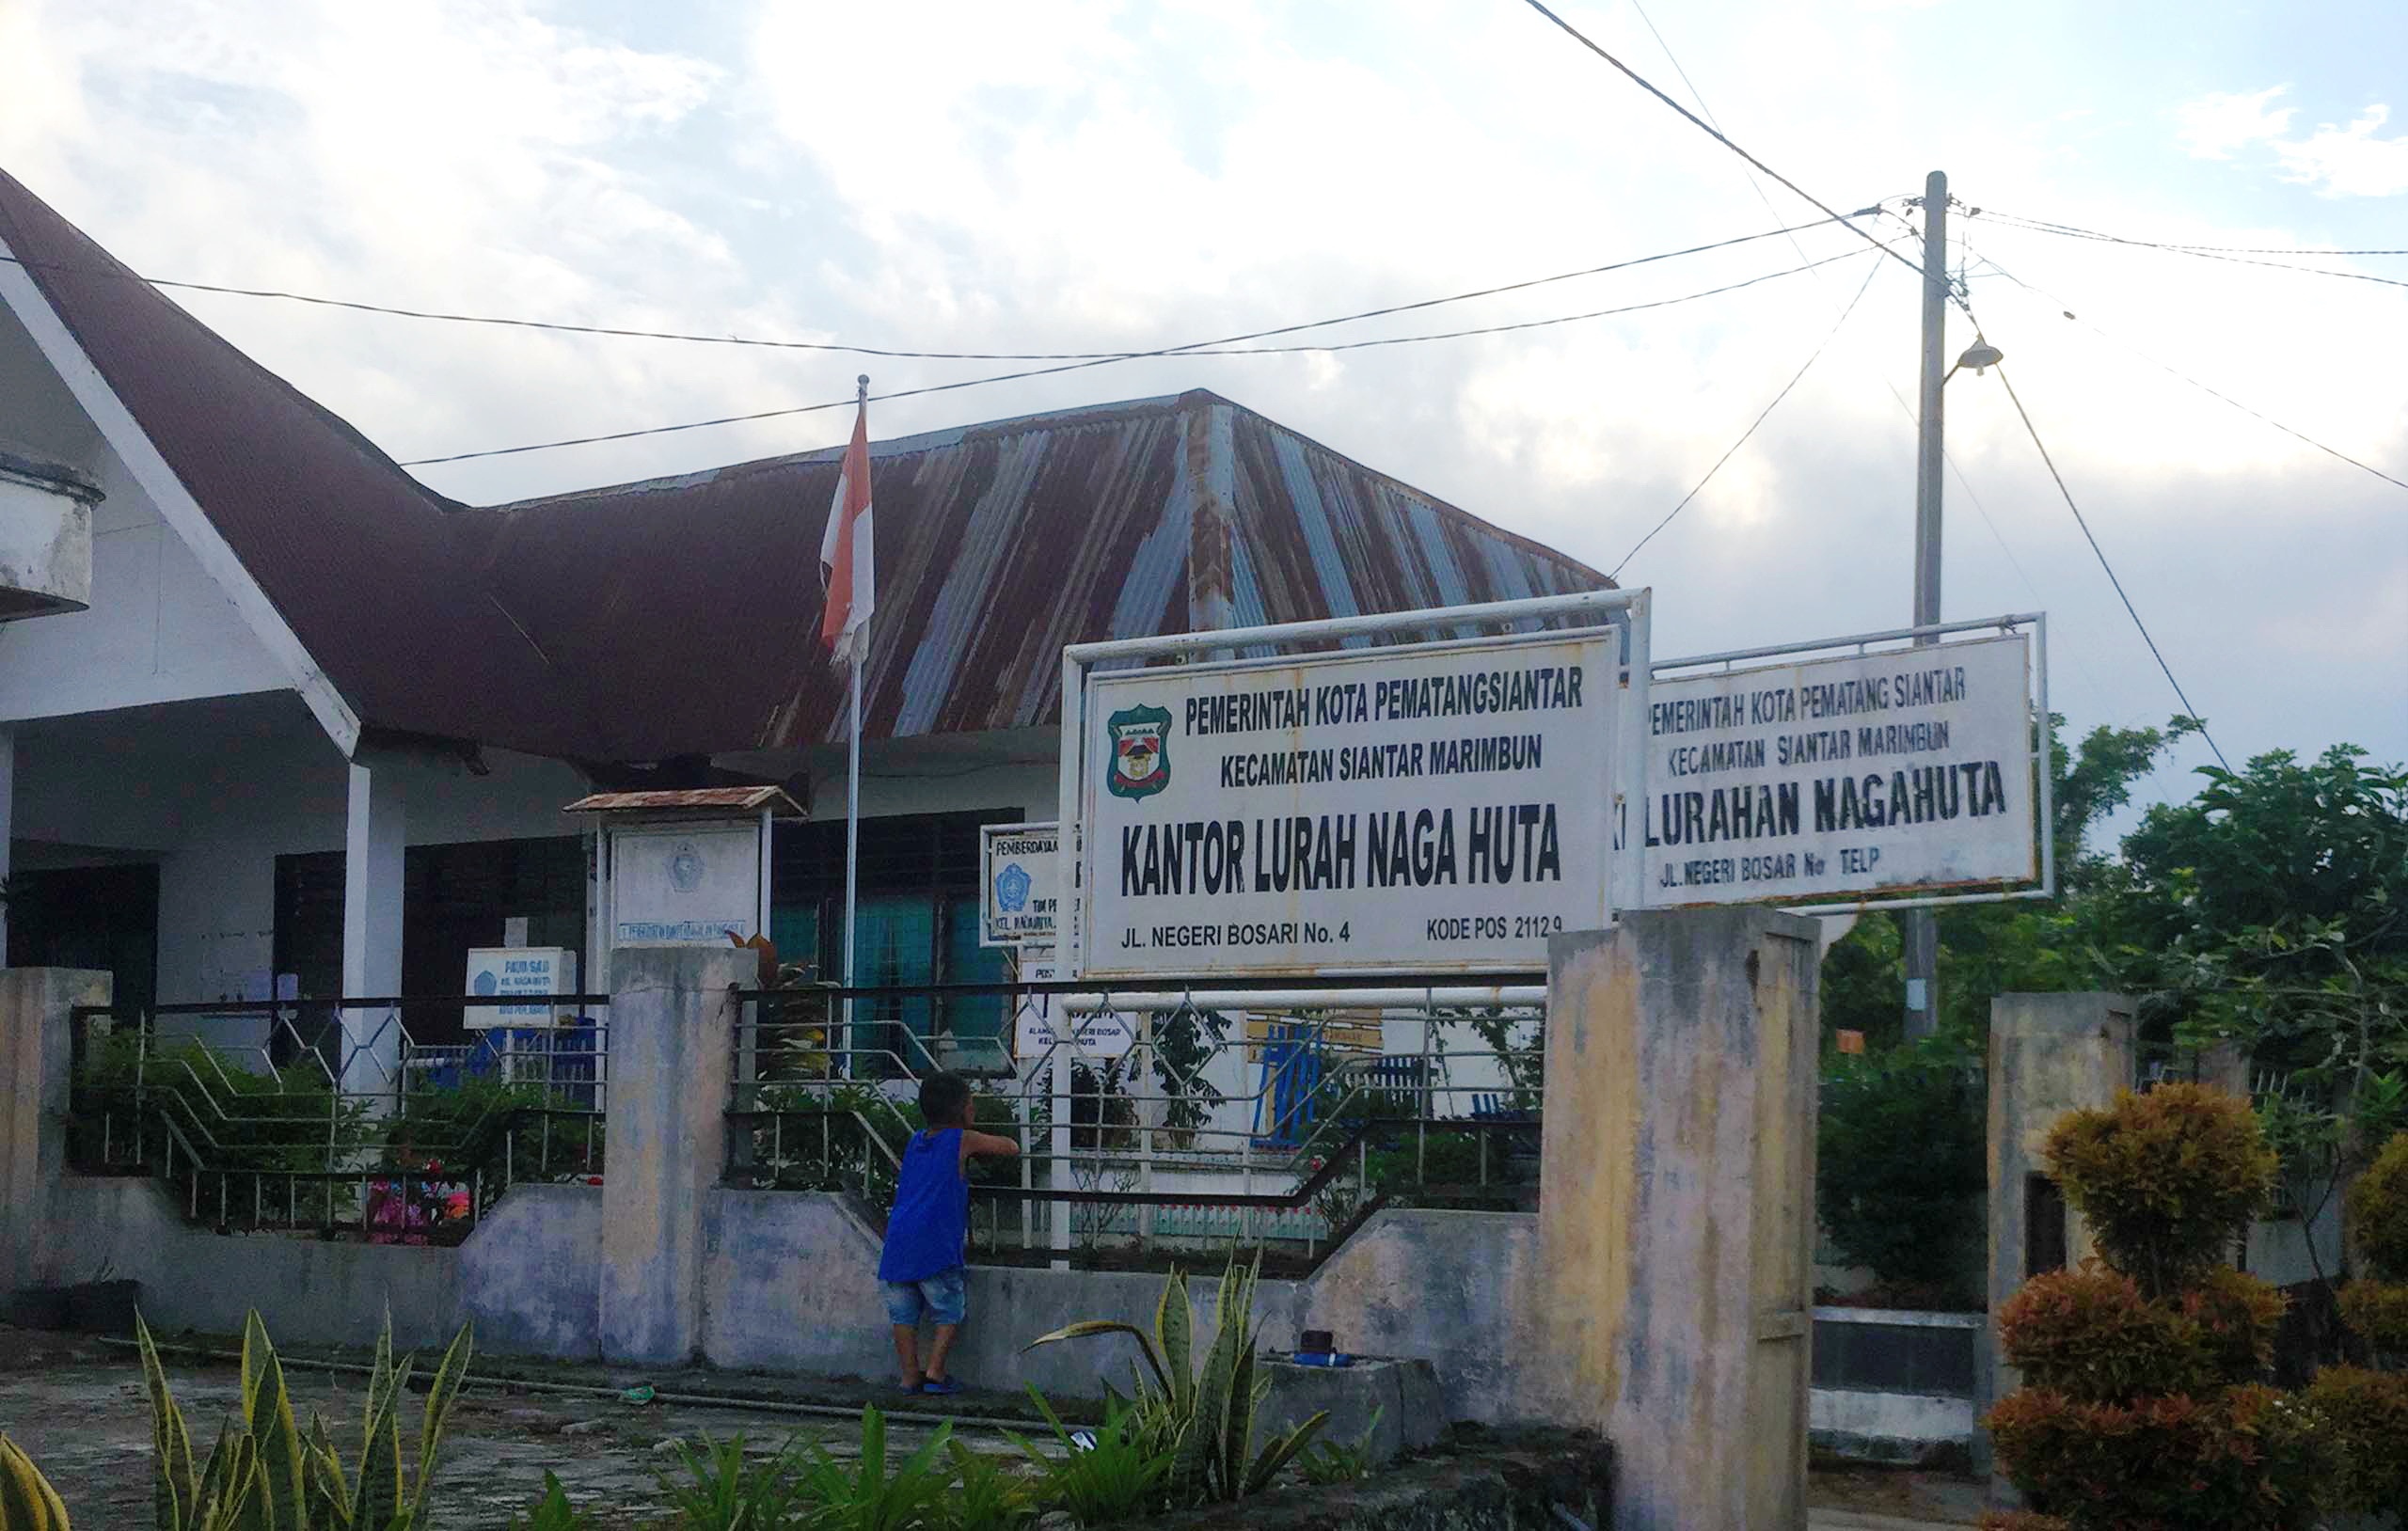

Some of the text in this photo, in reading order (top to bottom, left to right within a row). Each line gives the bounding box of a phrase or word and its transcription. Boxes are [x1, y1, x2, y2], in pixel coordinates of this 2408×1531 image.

[1186, 667, 1582, 736] PEMERINTAH KOTA PEMATANGSIANTAR
[1751, 688, 1796, 724] KOTA
[1800, 677, 1889, 719] PEMATANG
[1894, 667, 1965, 707] SIANTAR
[1221, 734, 1542, 788] KECAMATAN SIANTAR MARIMBUN
[1669, 720, 1949, 777] KECAMATAN SIANTAR MARIMBUN
[1614, 761, 2006, 851] LURAHAN NAGAHUTA
[996, 840, 1059, 857] PEMBERDAYAA
[1122, 804, 1560, 896] KANTOR LURAH NAGA HUTA
[1741, 853, 1796, 881] BOSAR
[1840, 847, 1879, 875] TELP
[1121, 922, 1350, 948] JL. NEGERI BOSARI No. 4
[1427, 916, 1561, 940] KODE POS 21129
